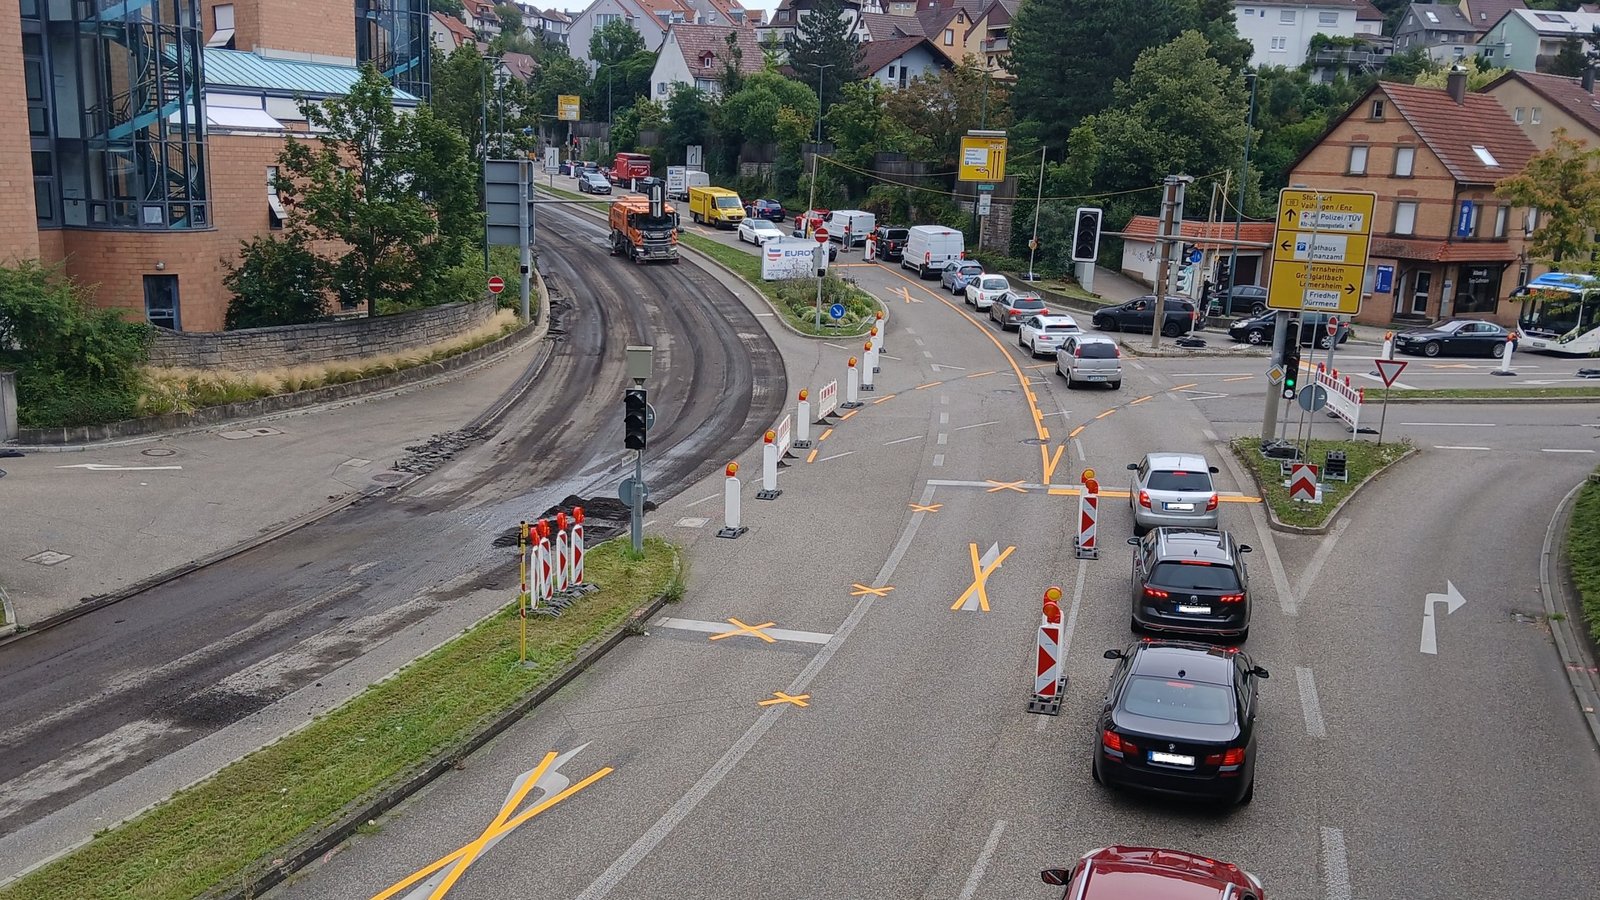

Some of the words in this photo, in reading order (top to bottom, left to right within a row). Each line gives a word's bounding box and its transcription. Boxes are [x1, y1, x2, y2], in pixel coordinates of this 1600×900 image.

[1302, 193, 1332, 201] Stutart
[1301, 202, 1334, 211] Vaihigen
[1307, 252, 1343, 260] Fnanzamt
[1309, 291, 1338, 299] Friedhof
